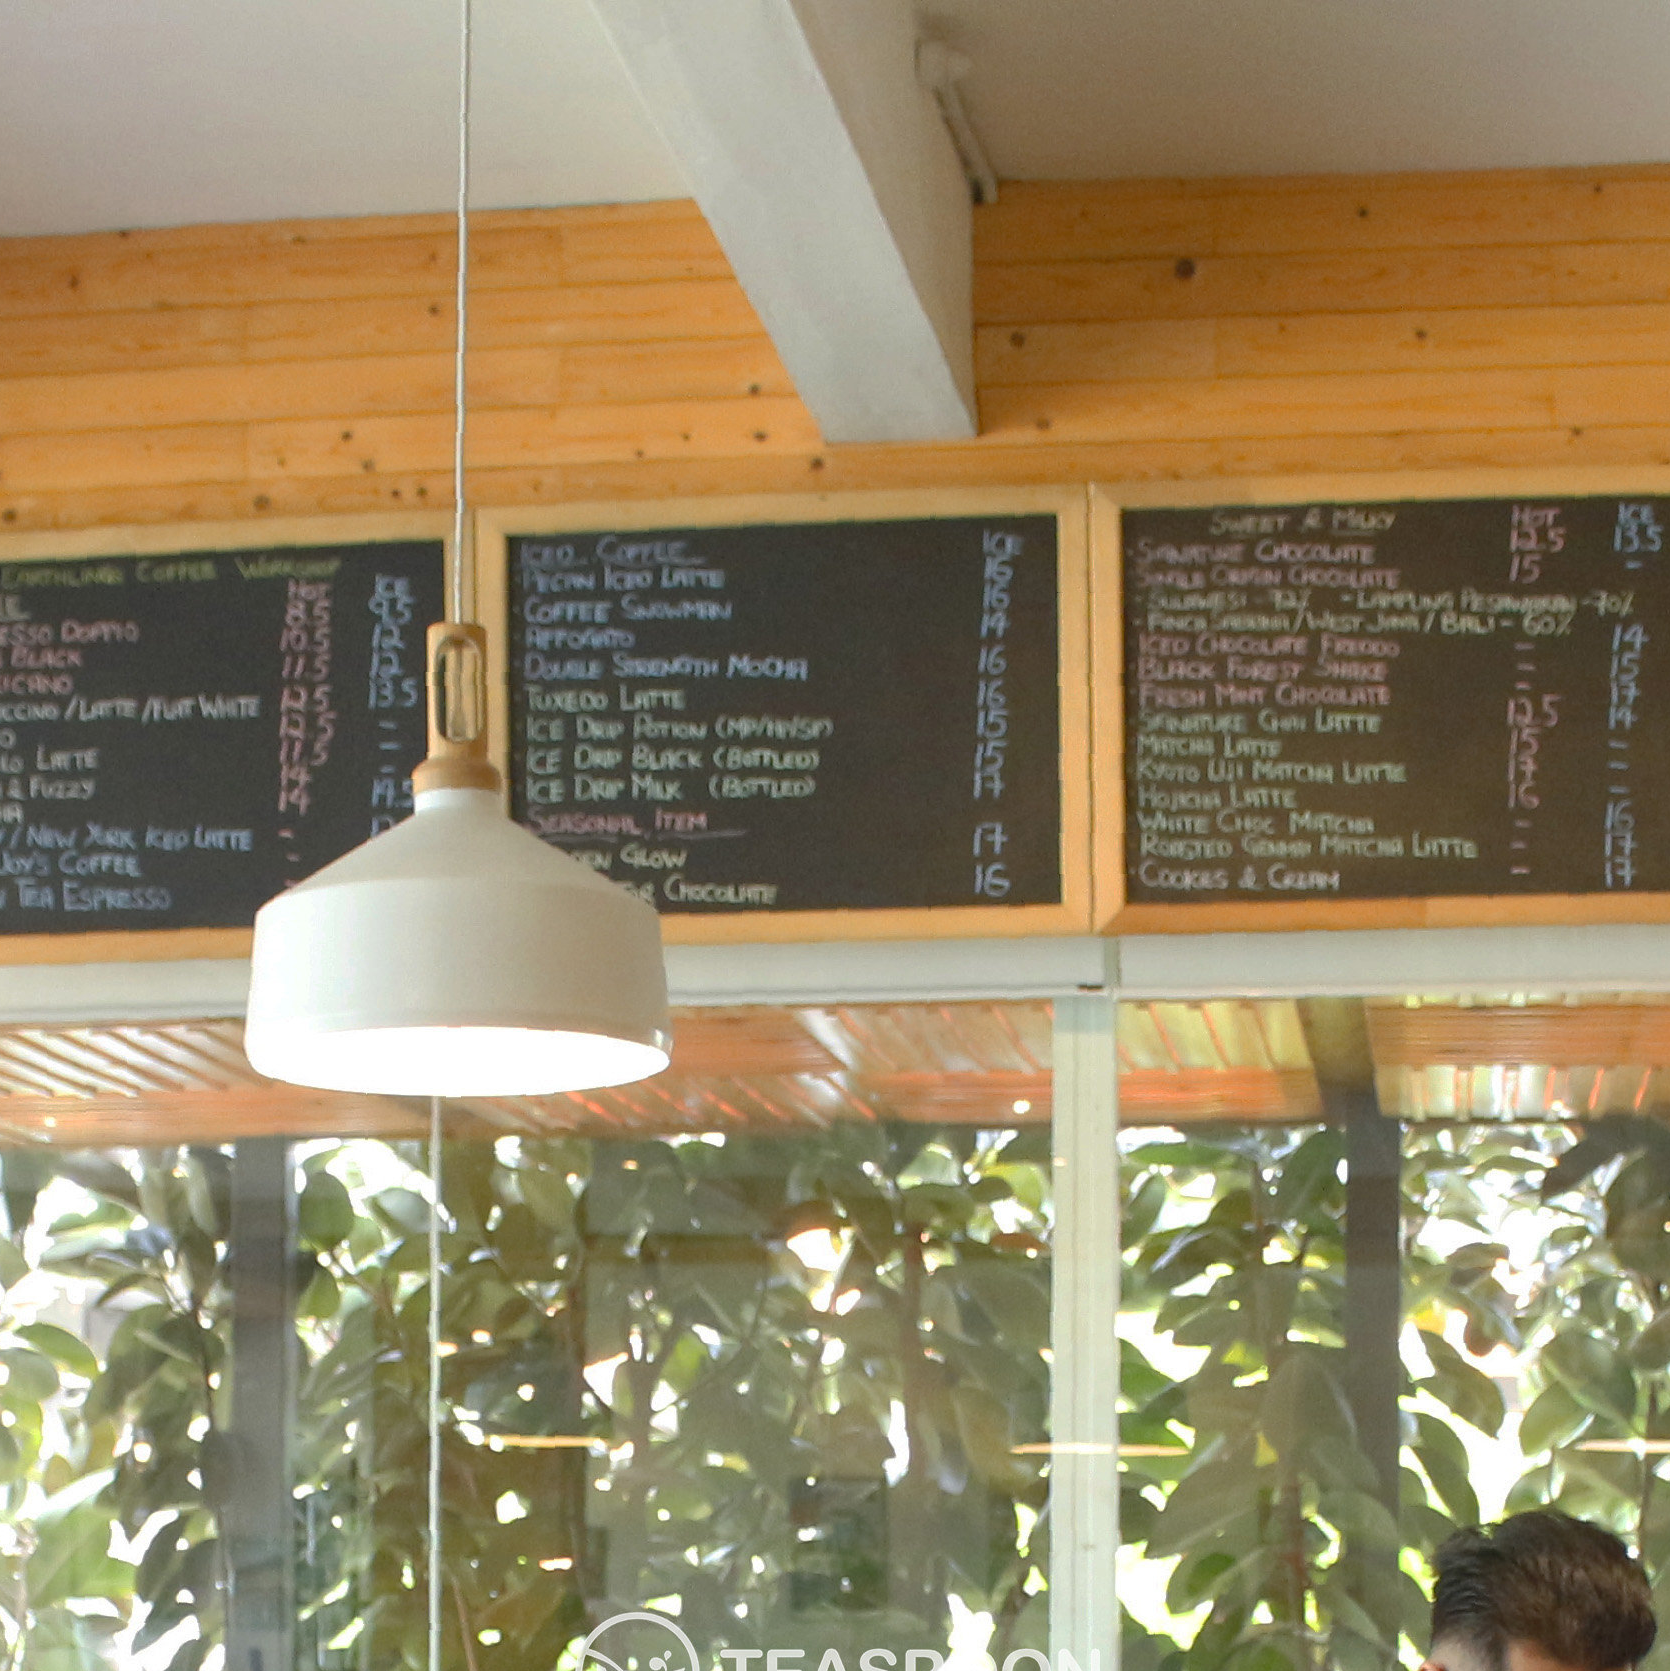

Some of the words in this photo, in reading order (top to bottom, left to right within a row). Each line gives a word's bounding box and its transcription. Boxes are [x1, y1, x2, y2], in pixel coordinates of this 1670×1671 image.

[1508, 553, 1543, 583] 15
[1612, 621, 1650, 654] 14
[978, 645, 1008, 674] 16
[619, 841, 688, 869] GLOW
[974, 862, 1012, 898] 16
